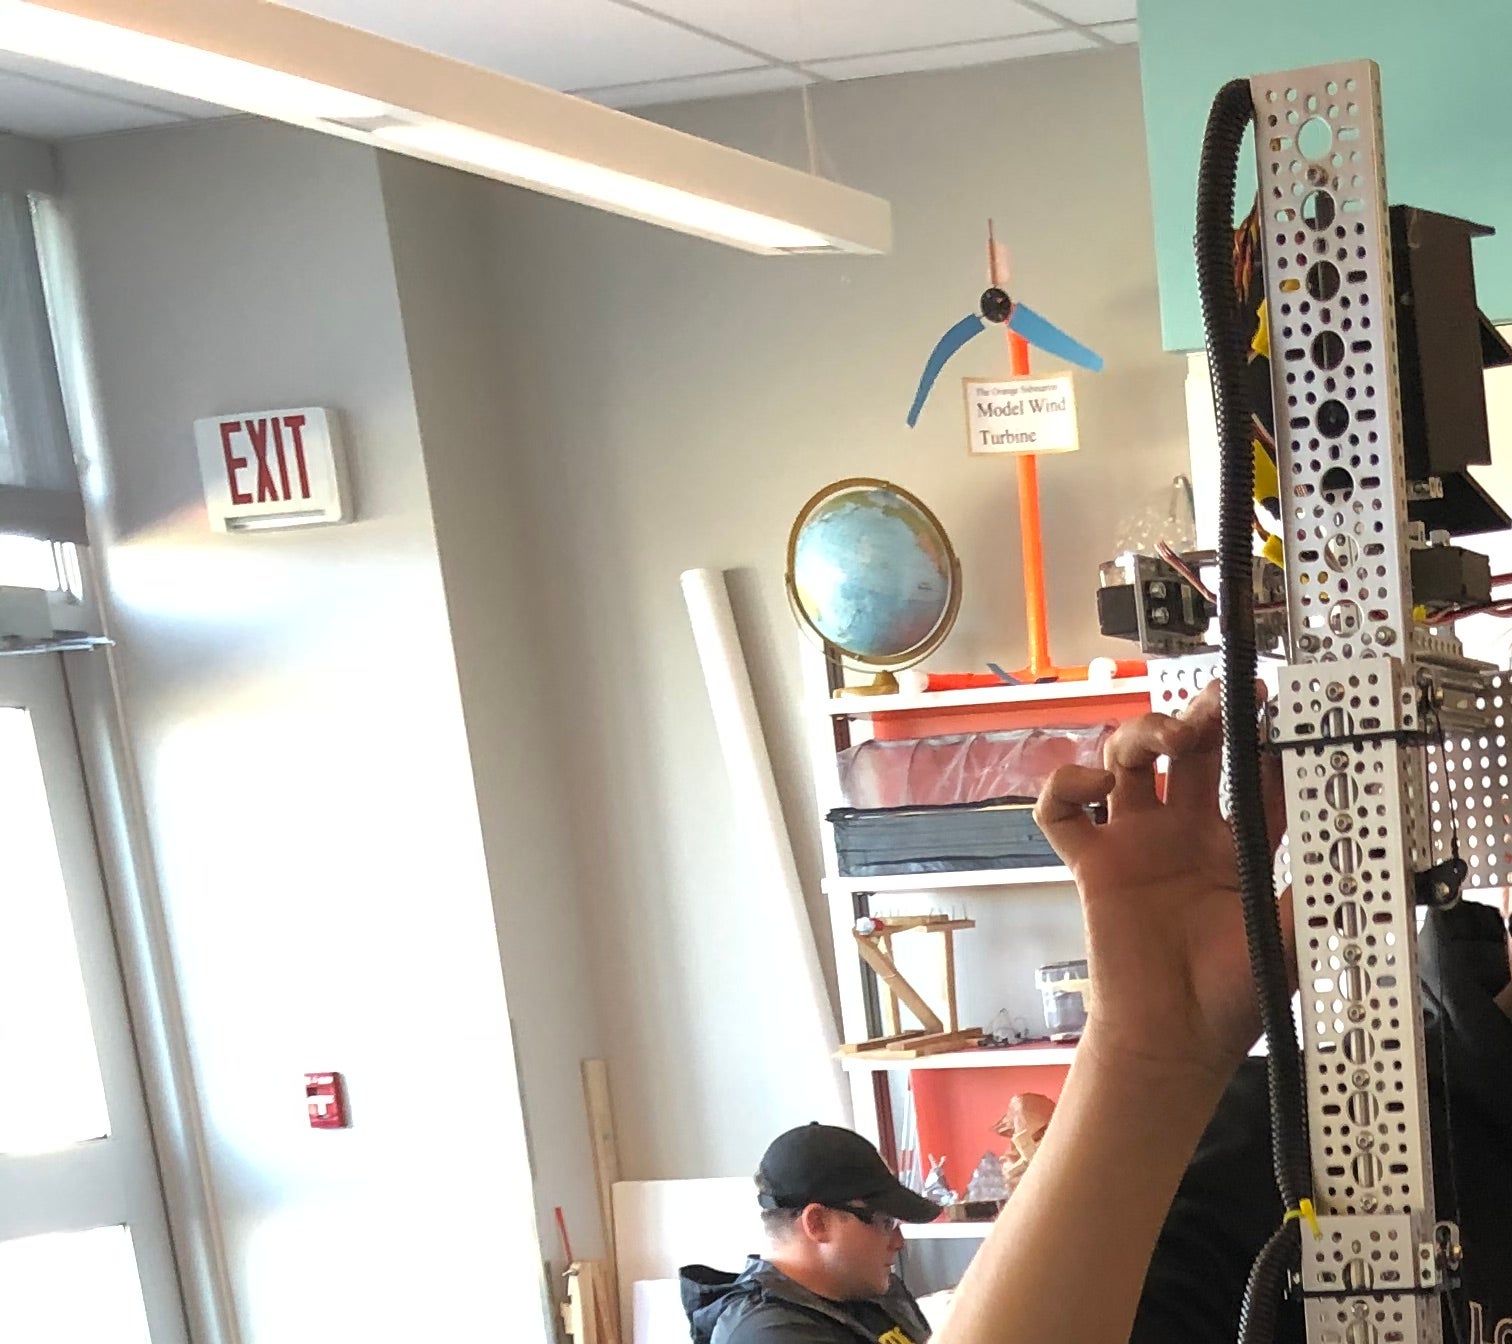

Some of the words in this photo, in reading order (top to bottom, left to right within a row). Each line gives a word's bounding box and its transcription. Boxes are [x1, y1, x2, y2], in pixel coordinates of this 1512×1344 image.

[976, 400, 1024, 418] Model
[1028, 397, 1066, 414] Wind
[978, 429, 1037, 446] Turbine
[219, 415, 311, 505] EXIT
